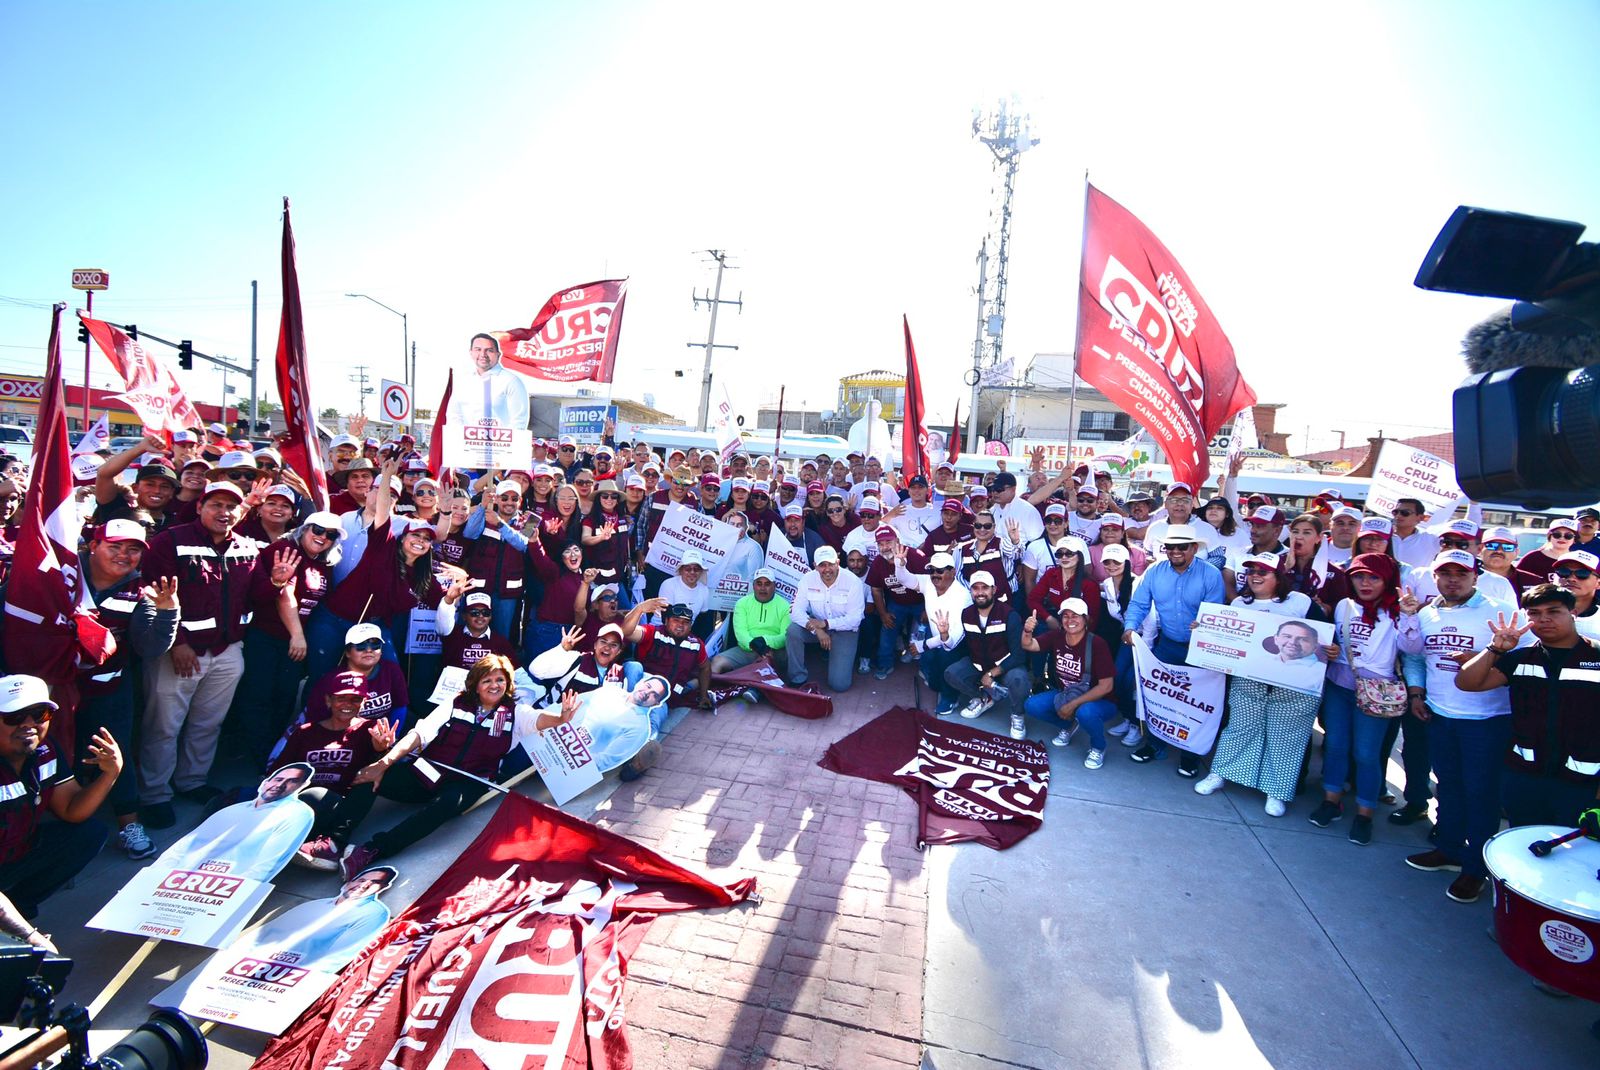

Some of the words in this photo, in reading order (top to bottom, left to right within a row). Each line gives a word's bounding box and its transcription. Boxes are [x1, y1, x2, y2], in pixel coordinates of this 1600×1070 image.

[73, 272, 101, 284] OXXO
[1158, 278, 1192, 333] VOTA
[1115, 352, 1172, 405] PRESIDENTE
[1170, 399, 1198, 447] MUNICIPAL
[1128, 378, 1164, 411] CIUDAD
[1135, 402, 1173, 440] CANDIDATO
[465, 428, 511, 441] CRUZ
[1024, 445, 1095, 457] LOTERIA
[1411, 456, 1439, 470] VOTA
[1404, 467, 1438, 484] CRUZ
[1412, 480, 1459, 501] CUÉLLAR
[689, 516, 713, 531] VOTA
[660, 527, 686, 543] PÉREZ
[688, 538, 726, 558] CUÉLLAR
[682, 526, 711, 543] CRUZ
[769, 551, 792, 567] PÉREZ
[718, 581, 749, 592] CRUZ
[1202, 614, 1254, 633] CRUZ
[1203, 643, 1240, 655] CAMBIO
[1425, 635, 1474, 648] CRUZ
[1057, 657, 1080, 672] CRUZ
[1151, 669, 1192, 691] CRUZ
[363, 694, 391, 710] RUZ
[1159, 685, 1215, 714] CUÉLLAR
[1147, 714, 1176, 736] rena
[556, 722, 592, 768] CRUZ
[308, 751, 351, 762] CRUZ
[200, 864, 231, 873] VOTA
[164, 871, 243, 897] CRUZ
[152, 890, 181, 900] PÉREZ
[182, 893, 224, 907] CUÉLLAR
[1546, 926, 1585, 945] CRUZ
[271, 953, 299, 964] VOTA
[232, 959, 309, 987] CRUZ
[247, 980, 287, 994] CUÉLLAR
